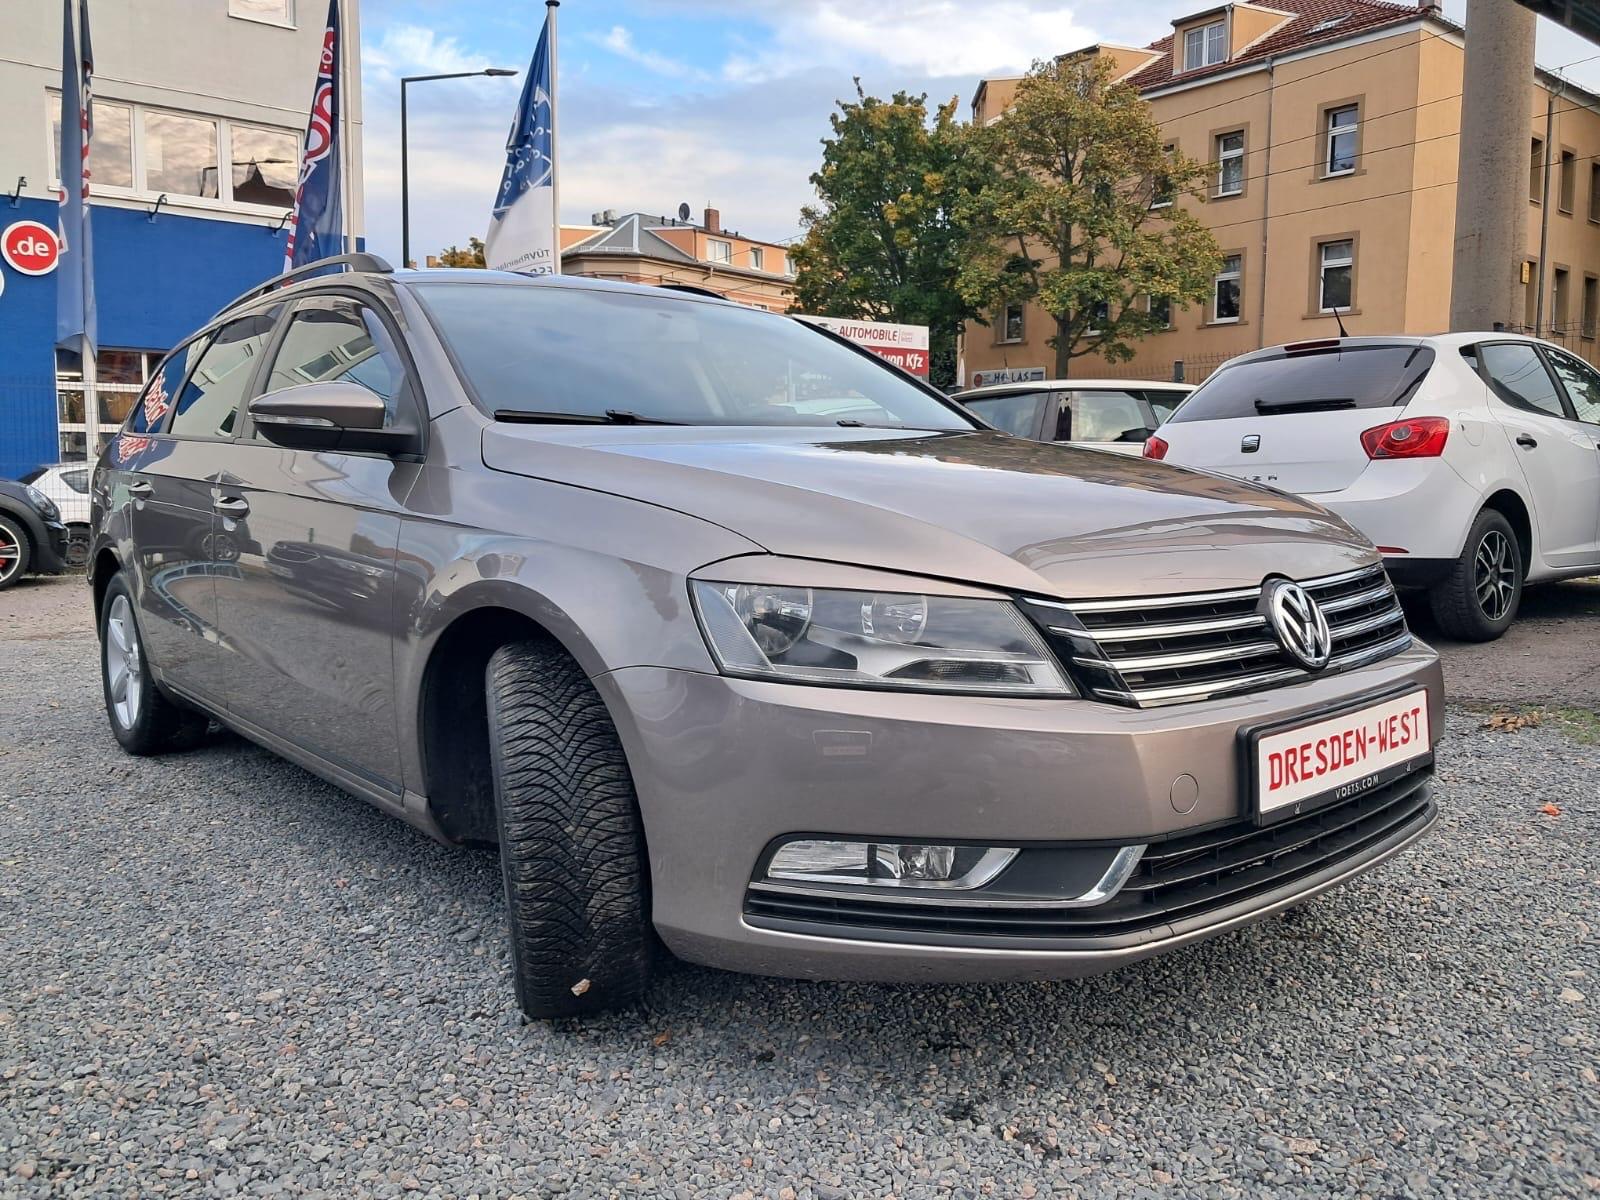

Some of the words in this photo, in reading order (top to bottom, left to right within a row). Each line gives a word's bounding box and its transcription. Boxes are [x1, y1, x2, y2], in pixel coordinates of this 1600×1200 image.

[12, 236, 50, 257] .de
[906, 353, 924, 370] Kfz
[1268, 707, 1421, 791] DRESDEN-WEST
[1334, 774, 1380, 800] VOETS.COM
